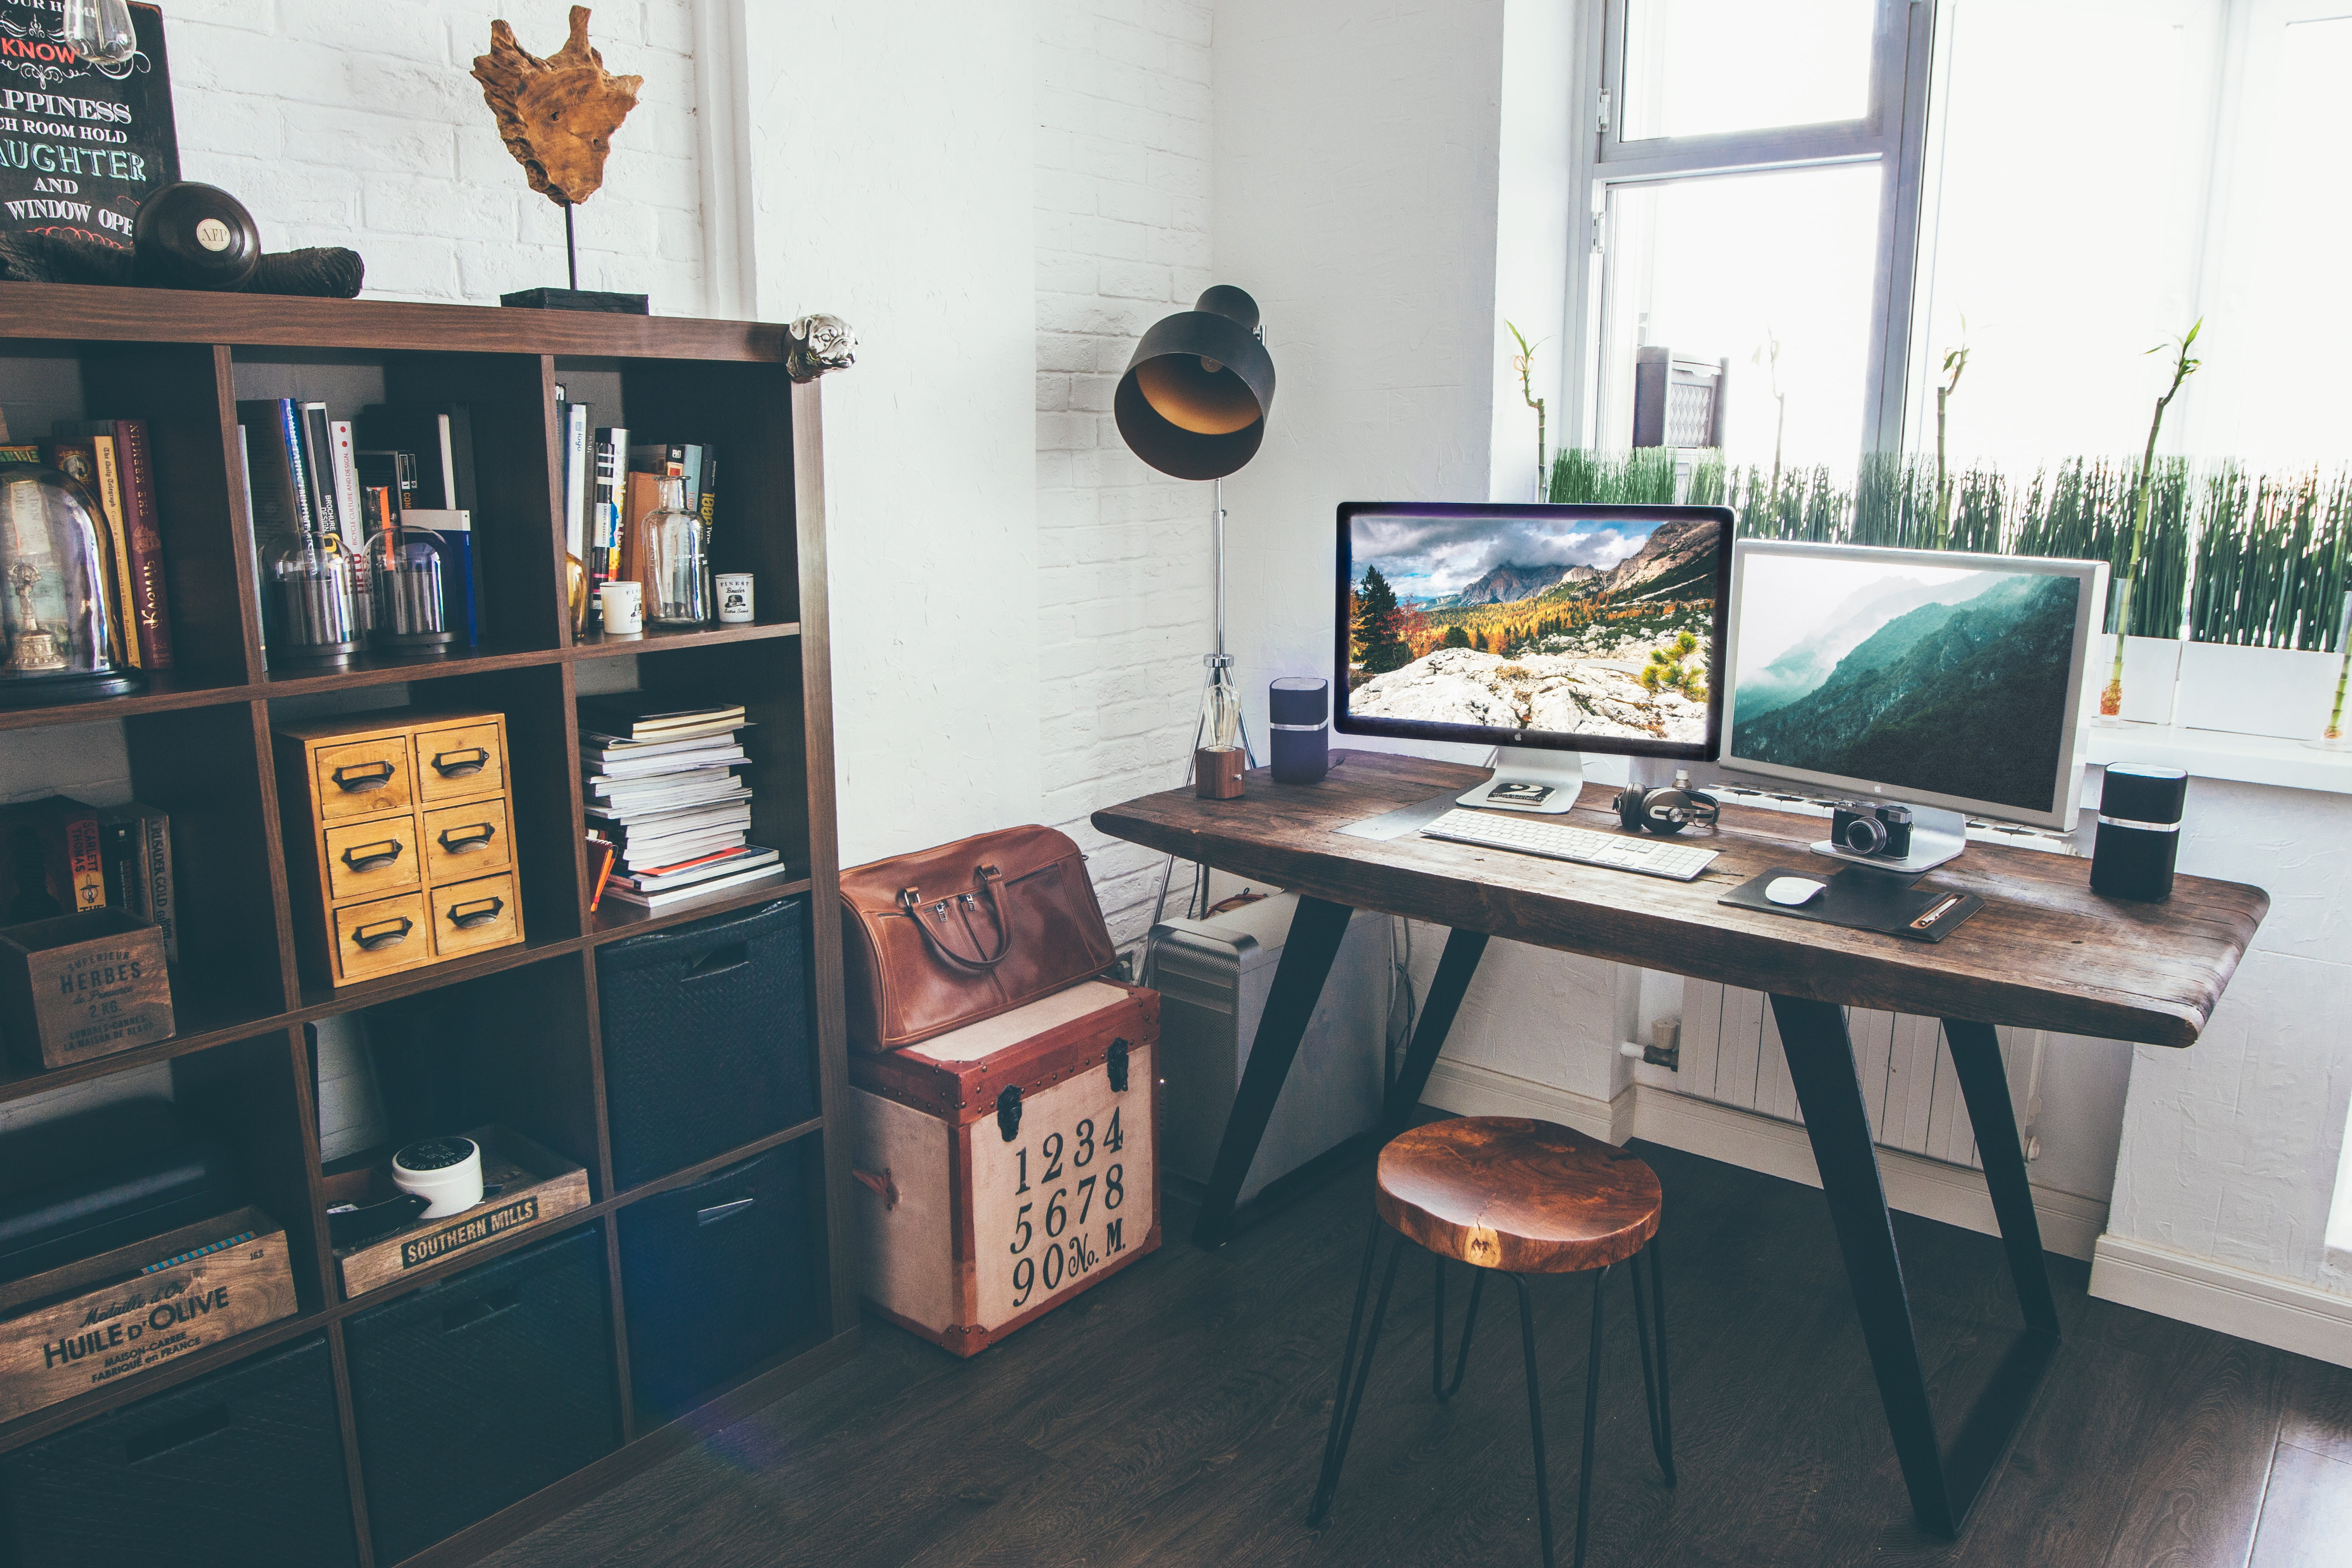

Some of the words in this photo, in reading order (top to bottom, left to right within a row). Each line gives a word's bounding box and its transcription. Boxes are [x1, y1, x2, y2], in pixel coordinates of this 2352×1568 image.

[1, 37, 80, 64] KNOW
[0, 89, 132, 124] PPINESS
[22, 120, 76, 138] ROOM
[79, 126, 128, 144] HOLD
[34, 177, 78, 194] AND
[5, 199, 92, 223] WINDOW
[98, 209, 134, 237] OPE
[201, 228, 227, 241] AFP
[130, 424, 145, 484] KREMLIN
[107, 478, 116, 508] Telegraph
[138, 491, 148, 516] THE
[321, 507, 329, 532] DESIGN
[325, 495, 336, 531] BROCHURE
[1500, 784, 1544, 796] 2
[72, 827, 86, 873] THOMAS
[83, 821, 98, 872] SCARLETT
[150, 821, 166, 877] CRUSADER
[155, 877, 168, 907] GOLD
[60, 962, 141, 994] HERBES
[89, 1004, 97, 1018] 2
[64, 1042, 75, 1051] LA
[77, 1033, 110, 1047] MAISON
[113, 1030, 124, 1039] DE
[407, 1218, 487, 1263] SOUTHERN
[490, 1201, 533, 1232] MILLS
[43, 1323, 124, 1369] HUILE
[144, 1353, 159, 1363] en
[161, 1336, 201, 1357] FRANCE
